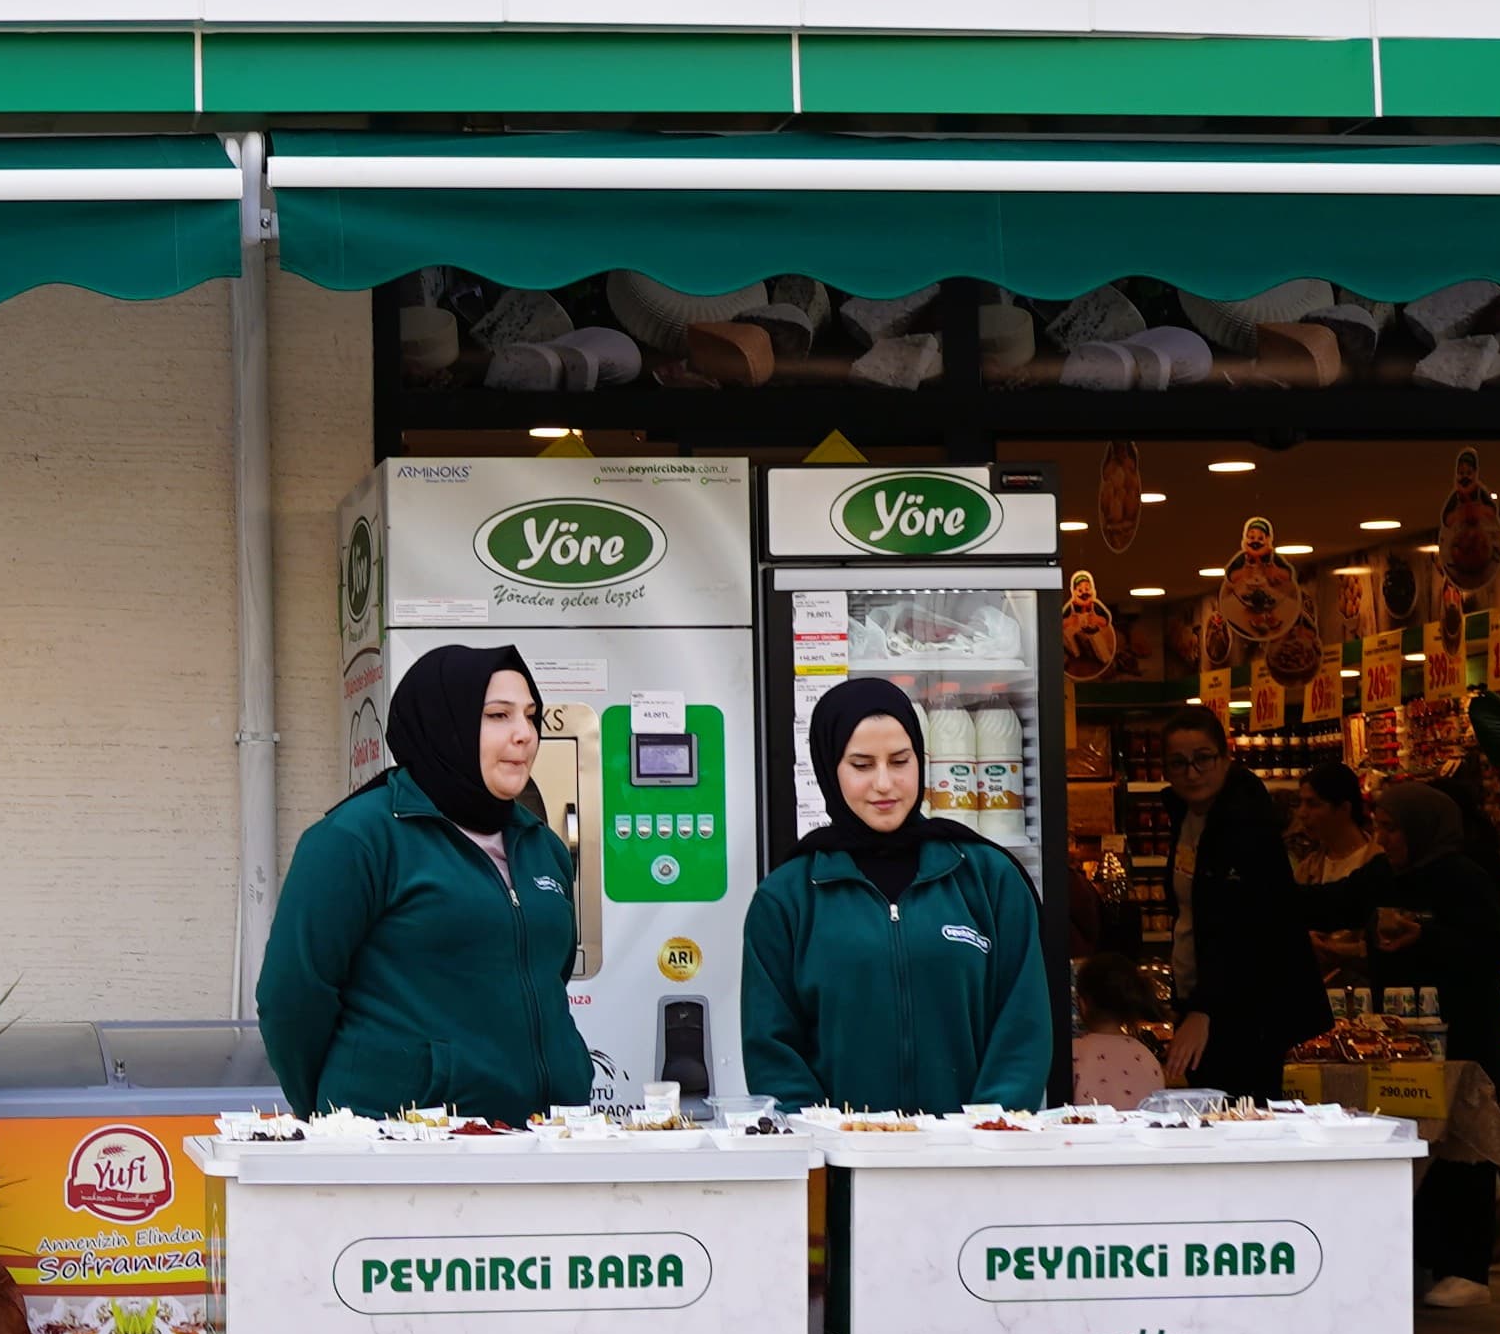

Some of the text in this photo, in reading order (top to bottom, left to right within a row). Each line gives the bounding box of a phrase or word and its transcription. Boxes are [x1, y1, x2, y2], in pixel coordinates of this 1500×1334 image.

[869, 490, 966, 542] Yöre
[516, 516, 625, 571] Yöre
[561, 591, 599, 610] gelen
[93, 1155, 148, 1191] Yufi
[37, 1225, 203, 1254] Annenizin Elinden
[37, 1250, 204, 1283] Sofranıza
[568, 1254, 684, 1290] BABA
[1184, 1241, 1295, 1276] BABA
